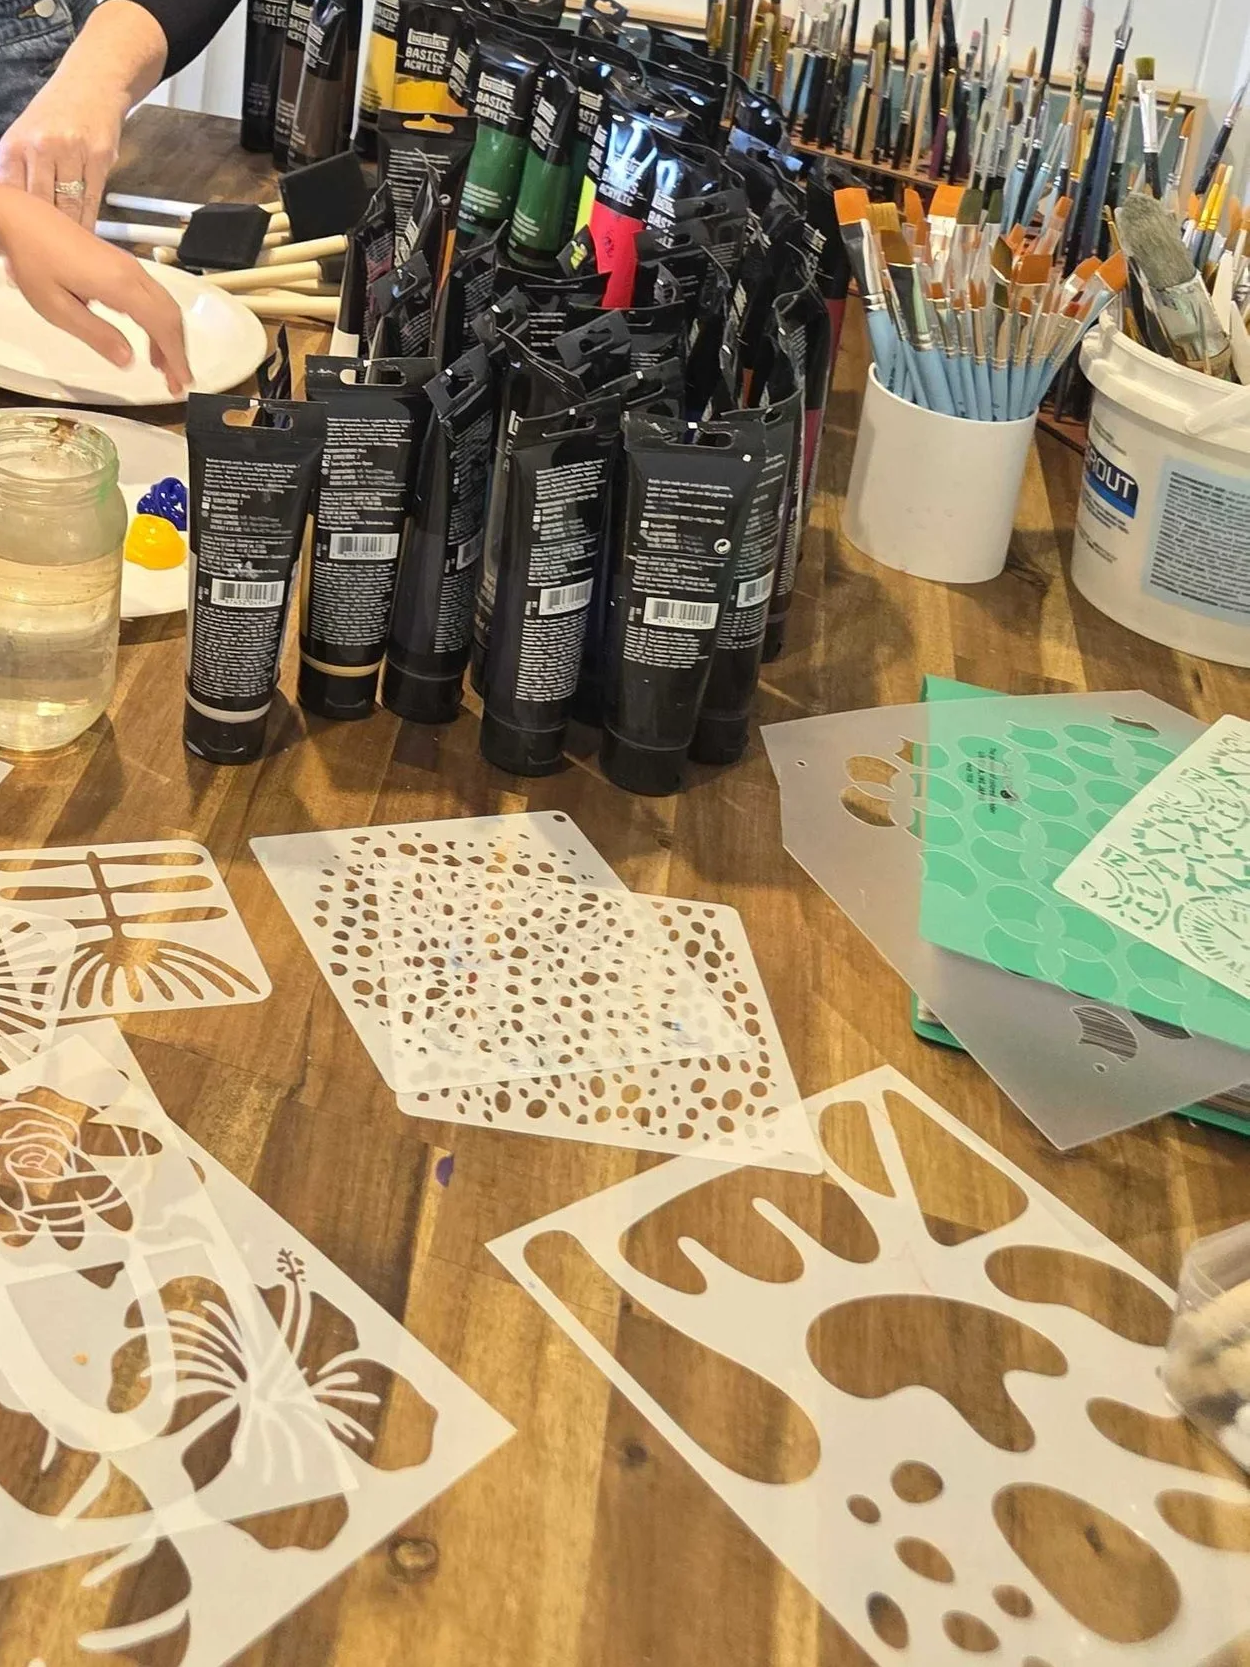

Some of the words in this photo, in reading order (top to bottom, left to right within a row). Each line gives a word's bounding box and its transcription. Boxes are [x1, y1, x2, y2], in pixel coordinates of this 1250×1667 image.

[288, 18, 307, 33] BASI
[405, 46, 447, 64] BASICS
[404, 58, 444, 75] ACRYLIC
[476, 91, 513, 114] BASICS
[473, 104, 509, 125] ACRYLIC
[1085, 446, 1136, 499] ROUT
